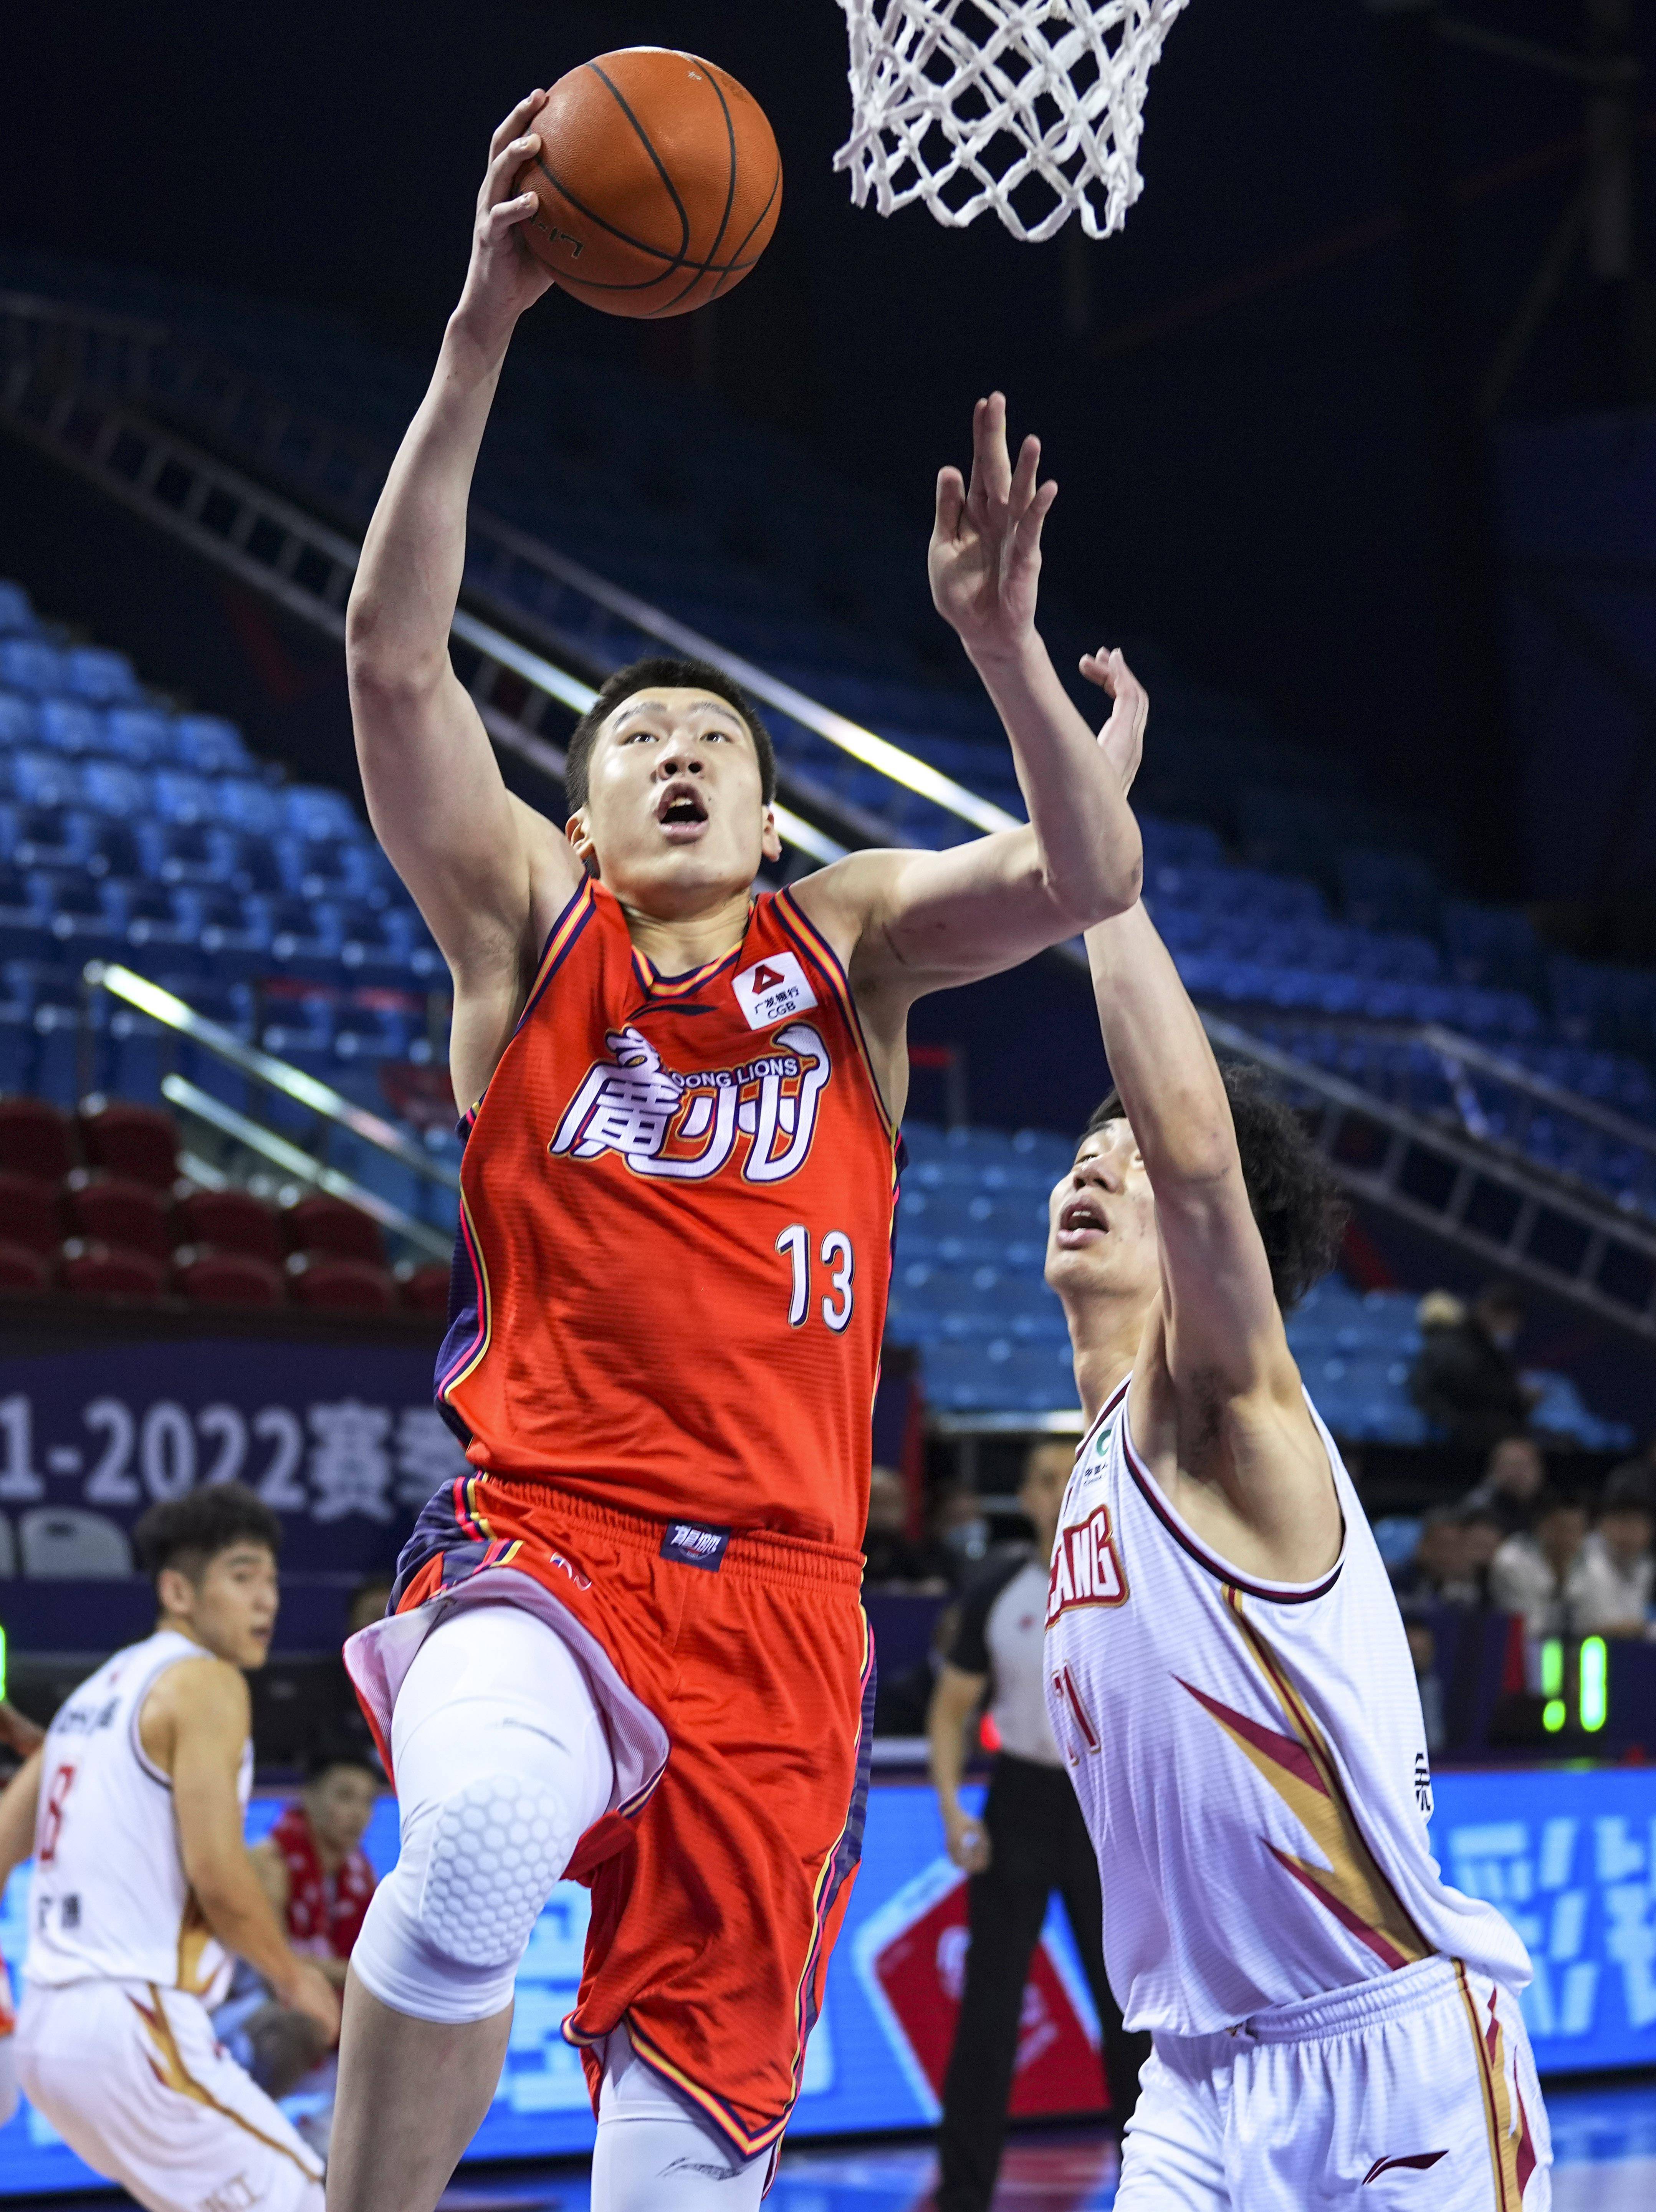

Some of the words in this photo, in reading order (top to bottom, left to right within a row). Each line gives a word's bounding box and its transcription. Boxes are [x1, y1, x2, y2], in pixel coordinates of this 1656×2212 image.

[768, 1000, 796, 1019] CGB
[736, 1058, 798, 1084] LIONS
[775, 1223, 855, 1335] 13
